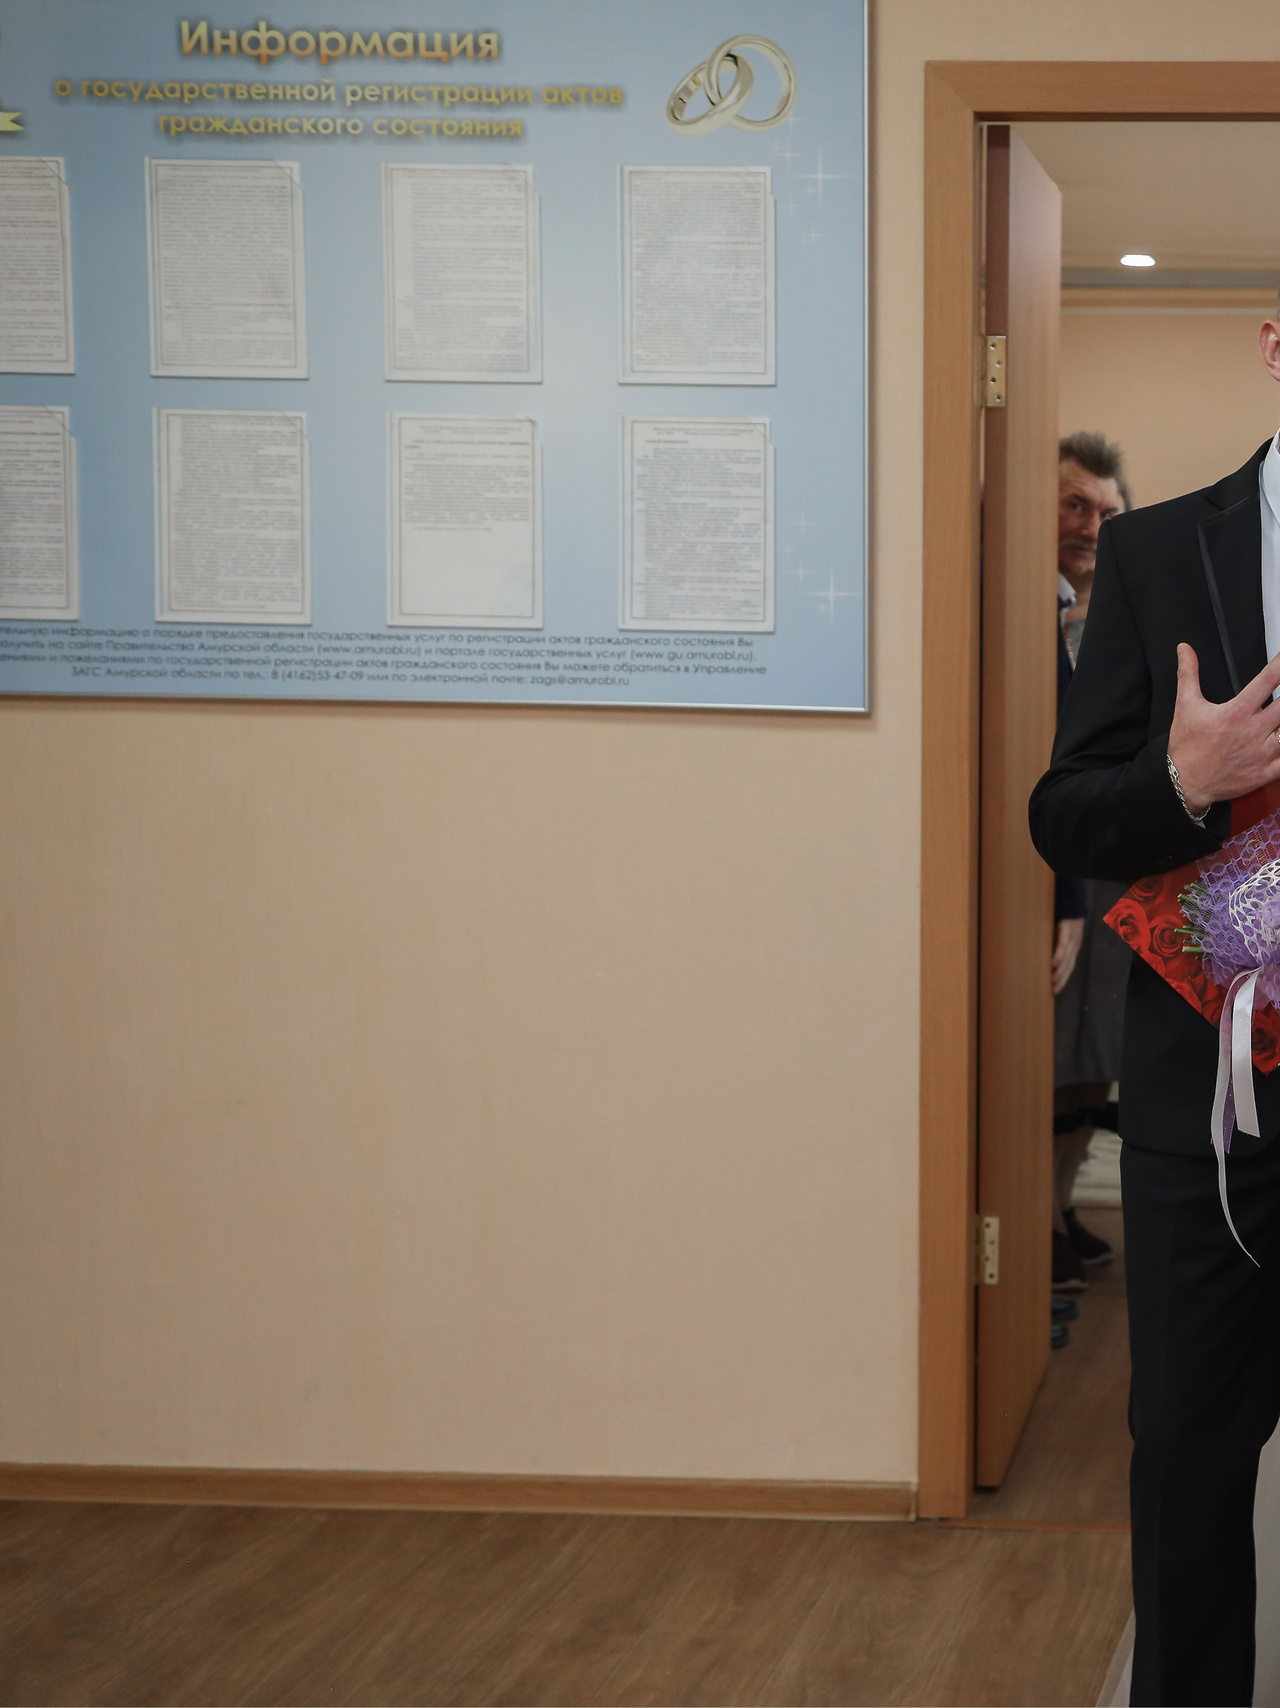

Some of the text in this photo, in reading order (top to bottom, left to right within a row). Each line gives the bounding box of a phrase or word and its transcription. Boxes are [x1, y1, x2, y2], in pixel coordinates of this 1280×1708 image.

[180, 20, 499, 66] Информация
[55, 78, 624, 107] о государственной регистрации актов
[158, 115, 523, 137] гражданского состояния
[51, 626, 140, 639] информацию
[142, 629, 151, 637] о
[153, 629, 203, 640] порядке
[206, 630, 305, 641] предоставления
[307, 632, 411, 643] государственных
[415, 634, 446, 644] услуг
[449, 634, 465, 642] по
[467, 635, 546, 645] регистрации
[549, 636, 582, 644] актов
[584, 637, 671, 647] гражданского
[673, 638, 735, 647] состояния
[738, 637, 754, 647] Вы
[48, 641, 65, 649] на
[67, 639, 103, 649] сайте
[106, 640, 195, 653] Правительства
[198, 641, 261, 654] Амурской
[263, 642, 315, 653] области
[425, 647, 433, 655] и
[435, 647, 486, 657] портале
[488, 648, 592, 659] государственных
[596, 649, 627, 659] услуг
[49, 654, 57, 662] и
[60, 654, 145, 663] пожеланиями
[148, 656, 163, 664] по
[166, 654, 272, 667] государственной
[274, 658, 354, 668] регистрации
[356, 659, 388, 667] актов
[391, 660, 478, 670] гражданского
[480, 661, 542, 670] состояния
[545, 660, 560, 670] Вы
[563, 662, 611, 671] можете
[613, 661, 682, 674] обратиться
[684, 664, 691, 672] в
[693, 662, 768, 675] Управление
[71, 666, 102, 677] ЗАГС
[105, 667, 168, 679] Амурской
[171, 668, 222, 678] области
[224, 671, 240, 679] по
[271, 670, 280, 679] 8
[367, 673, 390, 681] или
[392, 673, 408, 681] по
[410, 672, 489, 684] электронной
